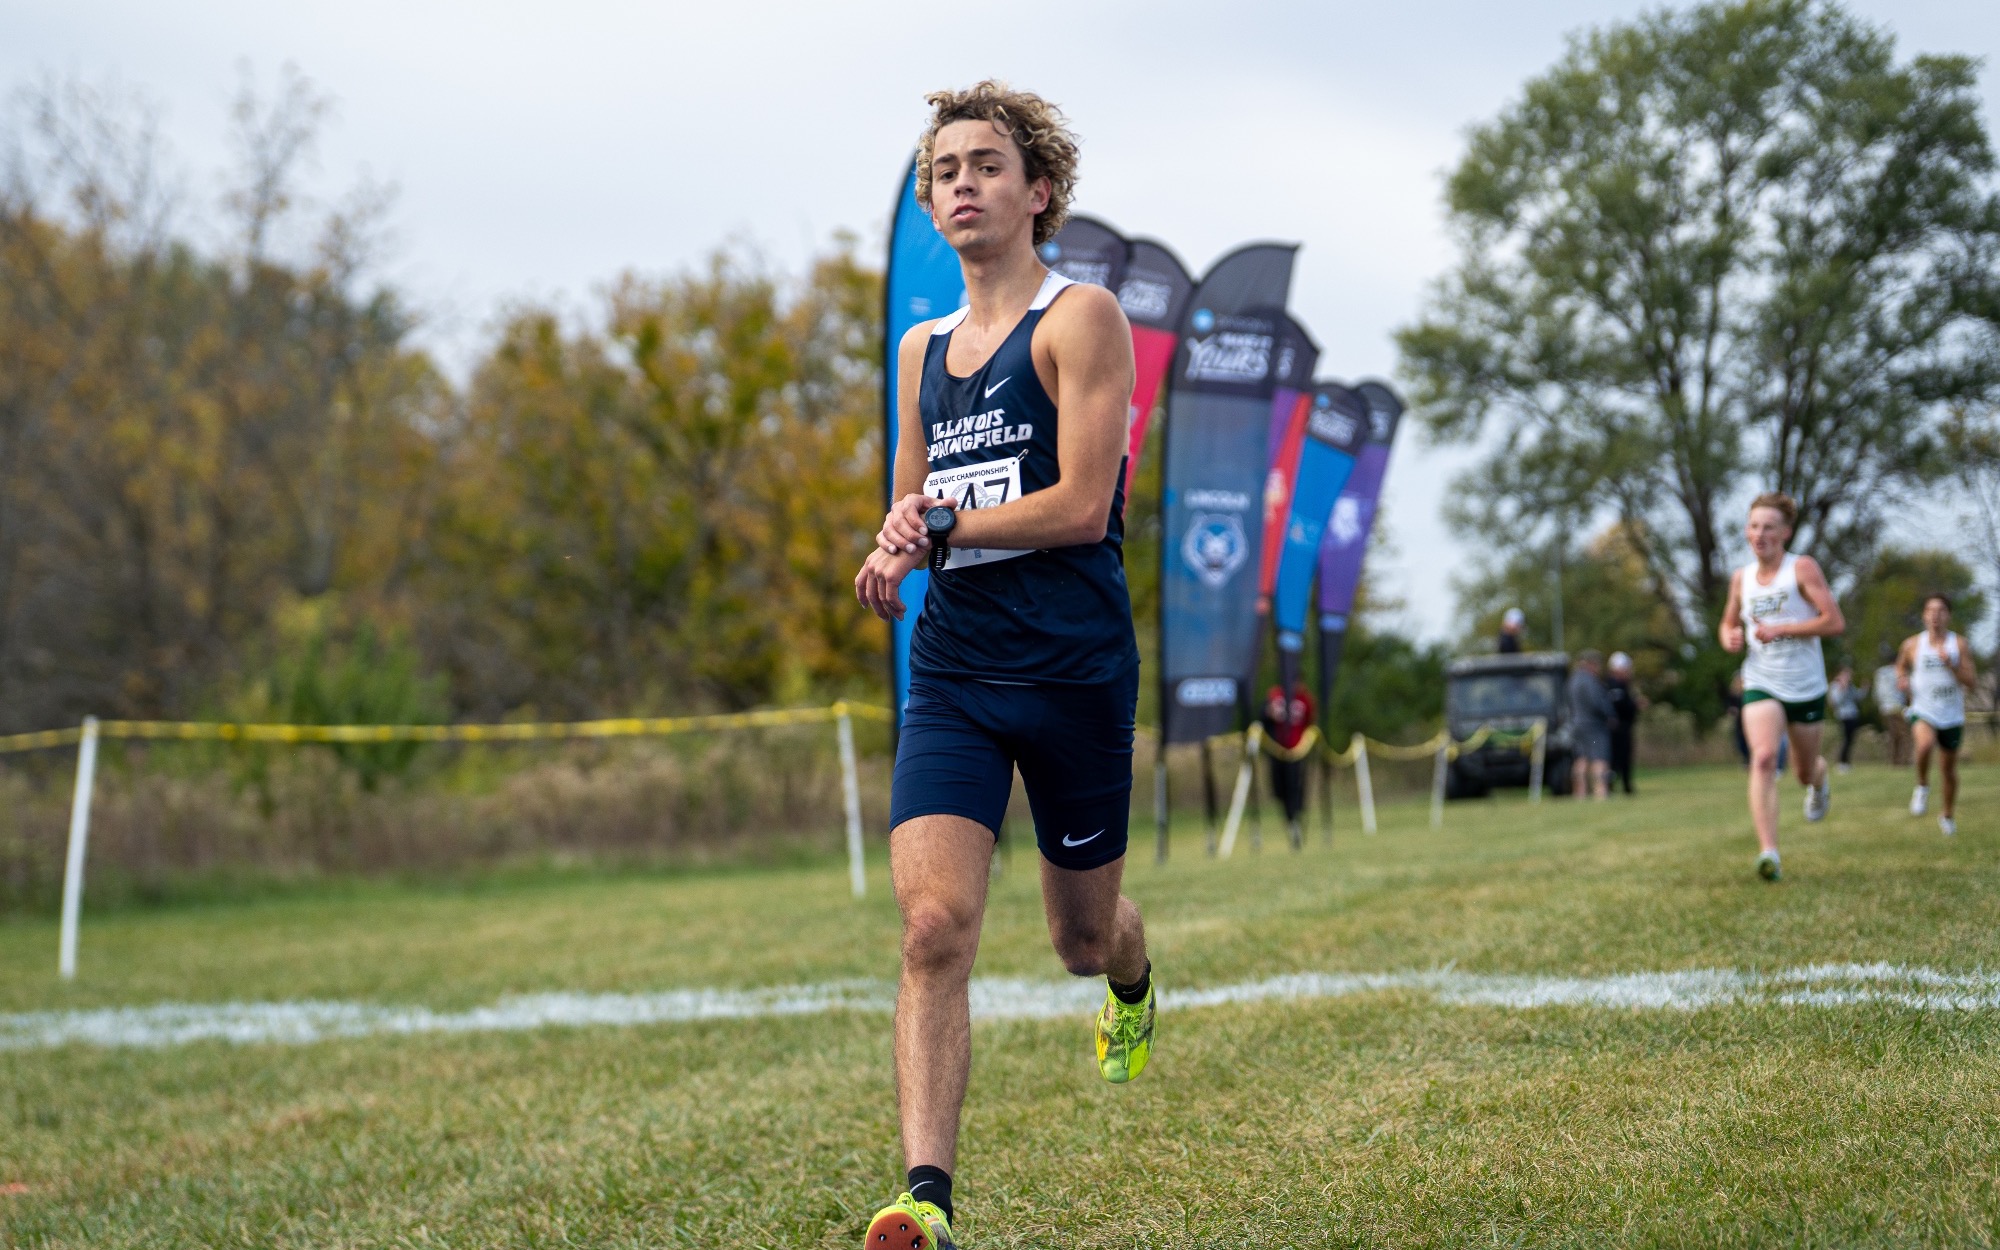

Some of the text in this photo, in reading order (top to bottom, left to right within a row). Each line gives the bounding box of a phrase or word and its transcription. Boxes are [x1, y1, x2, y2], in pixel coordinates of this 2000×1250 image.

[932, 408, 1005, 442] ILLINOIS
[940, 475, 956, 485] GLVC
[956, 465, 1009, 481] CHAMPIONSHIPS
